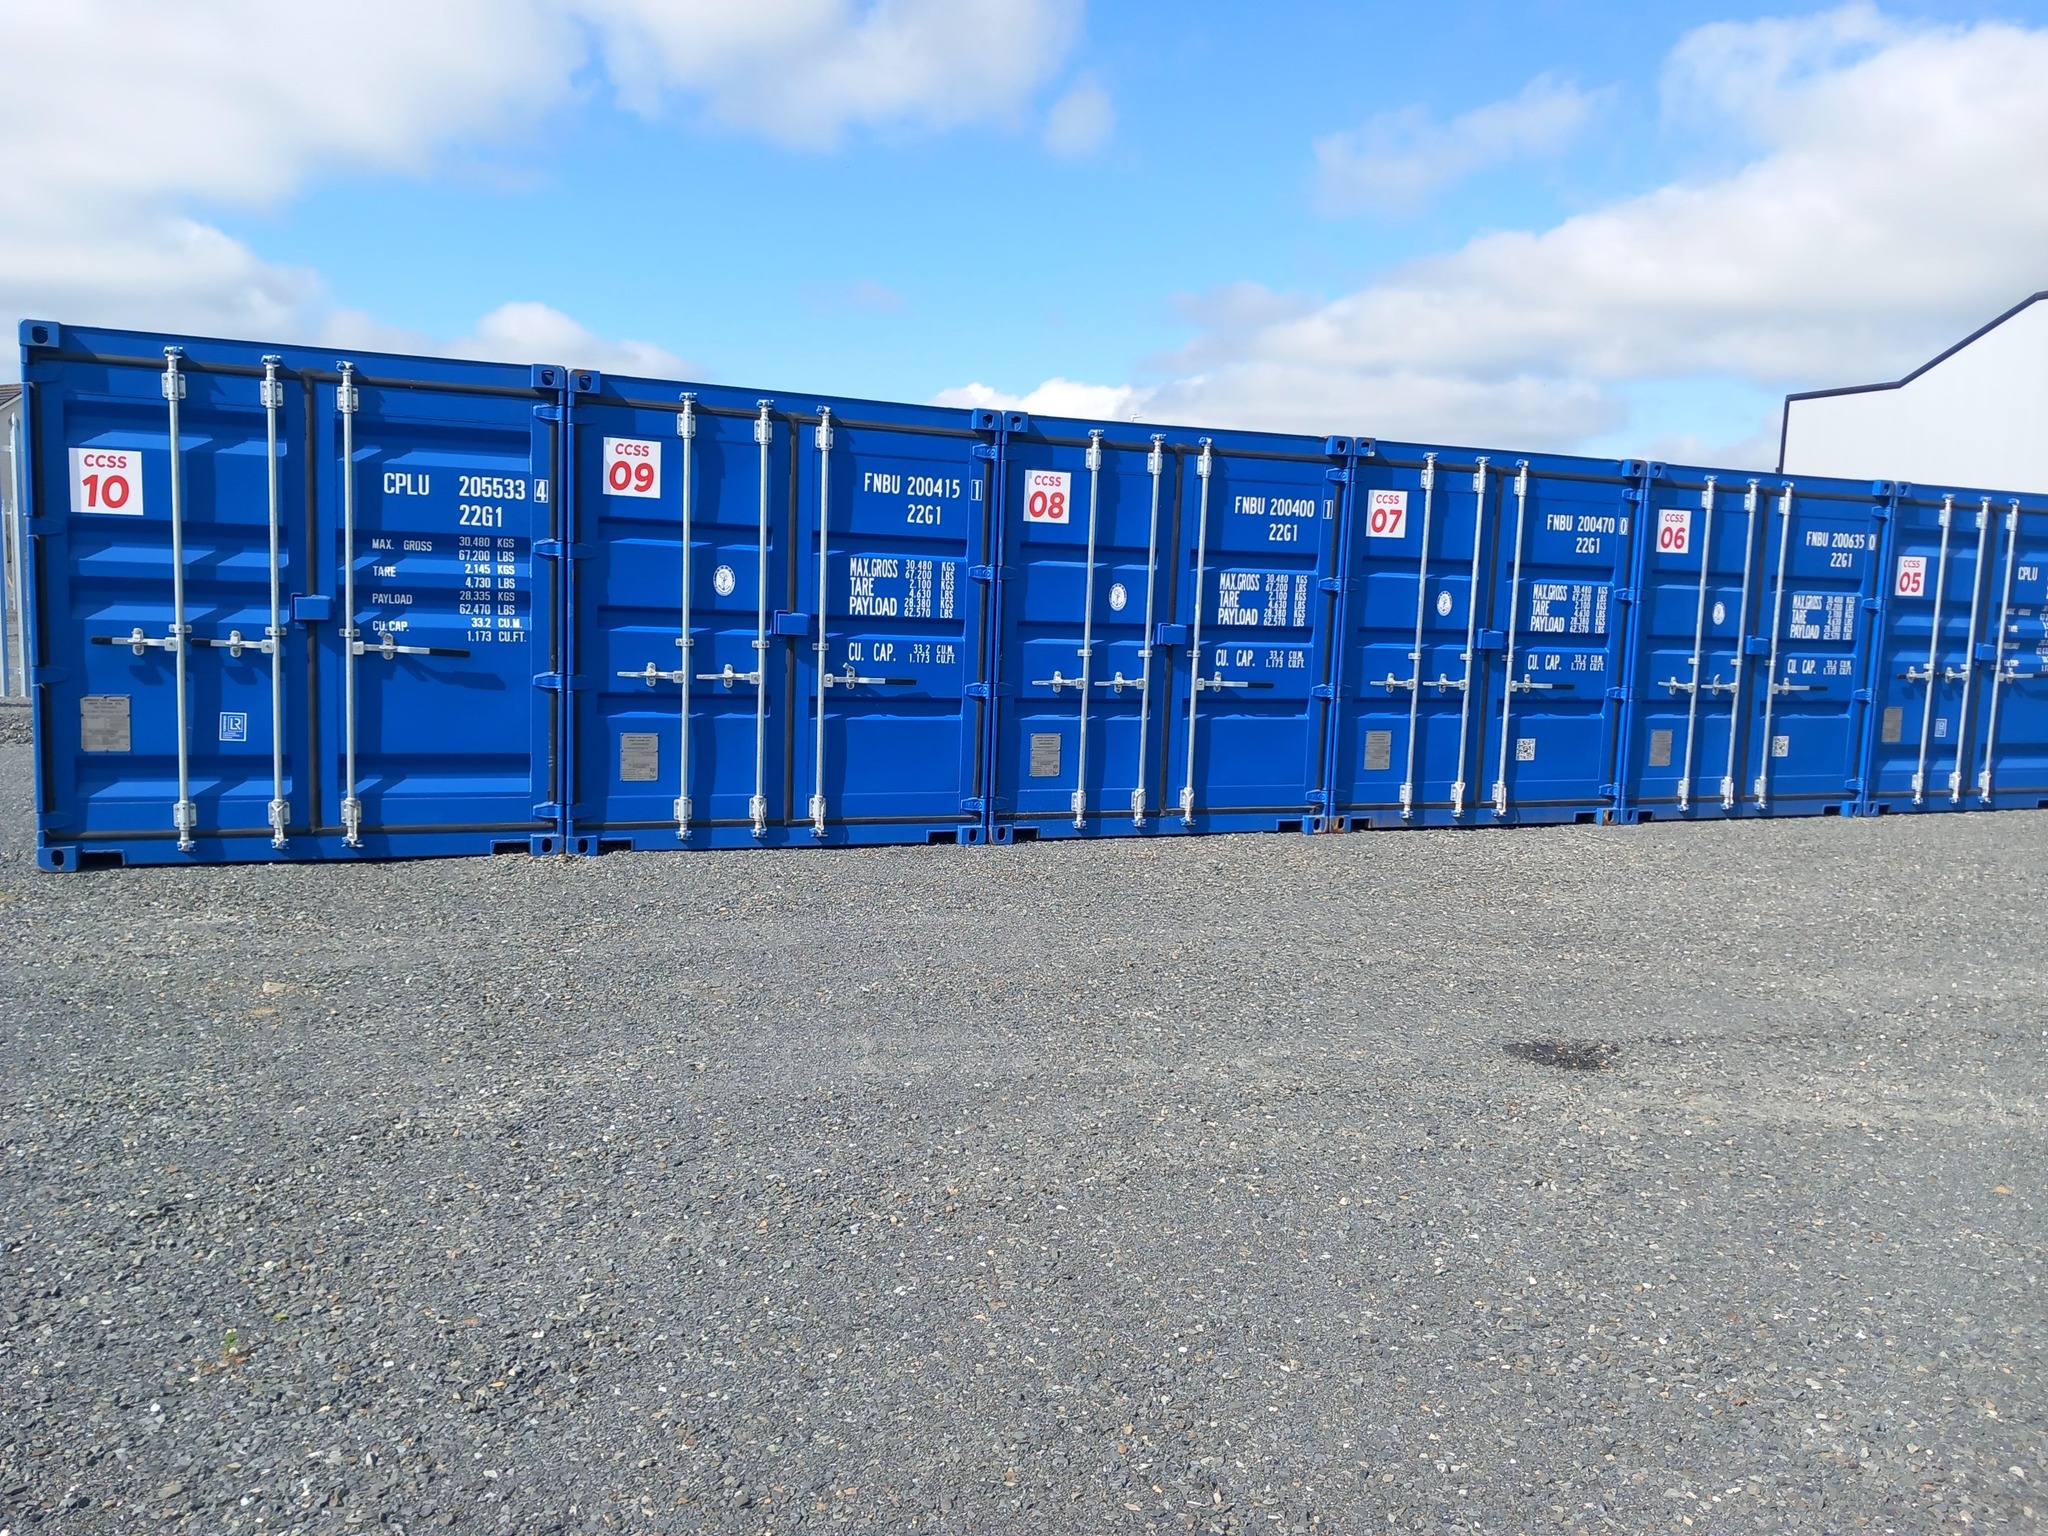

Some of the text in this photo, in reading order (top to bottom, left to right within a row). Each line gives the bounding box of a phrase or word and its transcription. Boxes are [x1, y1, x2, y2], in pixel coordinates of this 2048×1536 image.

[615, 443, 649, 457] CCSS
[84, 454, 127, 469] CCSS
[609, 461, 654, 492] 09
[1034, 475, 1061, 486] CCSS
[82, 474, 129, 508] 10
[383, 472, 547, 501] CPLU 205533 4
[864, 472, 900, 494] FNBU
[907, 476, 960, 499] 200415
[1029, 491, 1064, 519] 08
[1234, 496, 1266, 515] FNBU
[1269, 498, 1315, 518] 200400
[1376, 494, 1400, 504] CCSS
[459, 504, 503, 528] 22G1
[907, 504, 941, 525] 22G1
[1371, 508, 1402, 533] 07
[1665, 514, 1684, 522] CCSS
[1268, 523, 1298, 541] 22G1
[1546, 514, 1573, 531] FNBU
[1577, 516, 1615, 534] 200470
[372, 536, 515, 552] MAX. GROSS 30.480 KGS
[1575, 537, 1600, 554] 22G1
[1660, 526, 1686, 549] 06
[1806, 531, 1829, 547] FNBU
[1832, 532, 1865, 549] 200635
[458, 550, 515, 562] 67.200 LBS
[1830, 552, 1852, 568] 22G1
[1904, 560, 1920, 568] CCSS
[372, 564, 515, 577] TARE 2.145 KGS
[850, 557, 898, 578] MAX.GROSS
[905, 560, 955, 572] 30.480 KGS
[465, 577, 515, 589] 4.730 LBS
[905, 570, 955, 581] 67.200 LBS
[1900, 572, 1921, 592] 05
[850, 577, 874, 596] TARE
[909, 580, 955, 590] 2.100 KGS
[1295, 584, 1306, 592] LBS
[372, 590, 515, 605] PAYLOAD 28.335 KGS
[909, 589, 954, 600] 4.630 LBS
[1219, 591, 1240, 608] TARE
[459, 604, 515, 616] 62.470 LBS
[849, 597, 897, 616] PAYLOAD
[904, 598, 954, 609] 28.380 KGS
[1294, 601, 1306, 610] LBS
[1532, 600, 1550, 616] TARE
[904, 608, 953, 619] 62.570 LBS
[1218, 608, 1258, 625] PAYLOAD
[471, 617, 491, 628] 33.2
[498, 618, 522, 629] CU.M.
[1293, 618, 1304, 627] LBS
[1530, 616, 1565, 632] PAYLOAD
[467, 631, 527, 643] 1.173 CU.FT.
[848, 642, 896, 662] CU. CAP.
[913, 644, 930, 654] 33.2
[1269, 650, 1284, 659] 33.2
[909, 654, 930, 663] 1.173
[1216, 649, 1255, 667] CU. CAP.
[1545, 654, 1562, 670] CAP.
